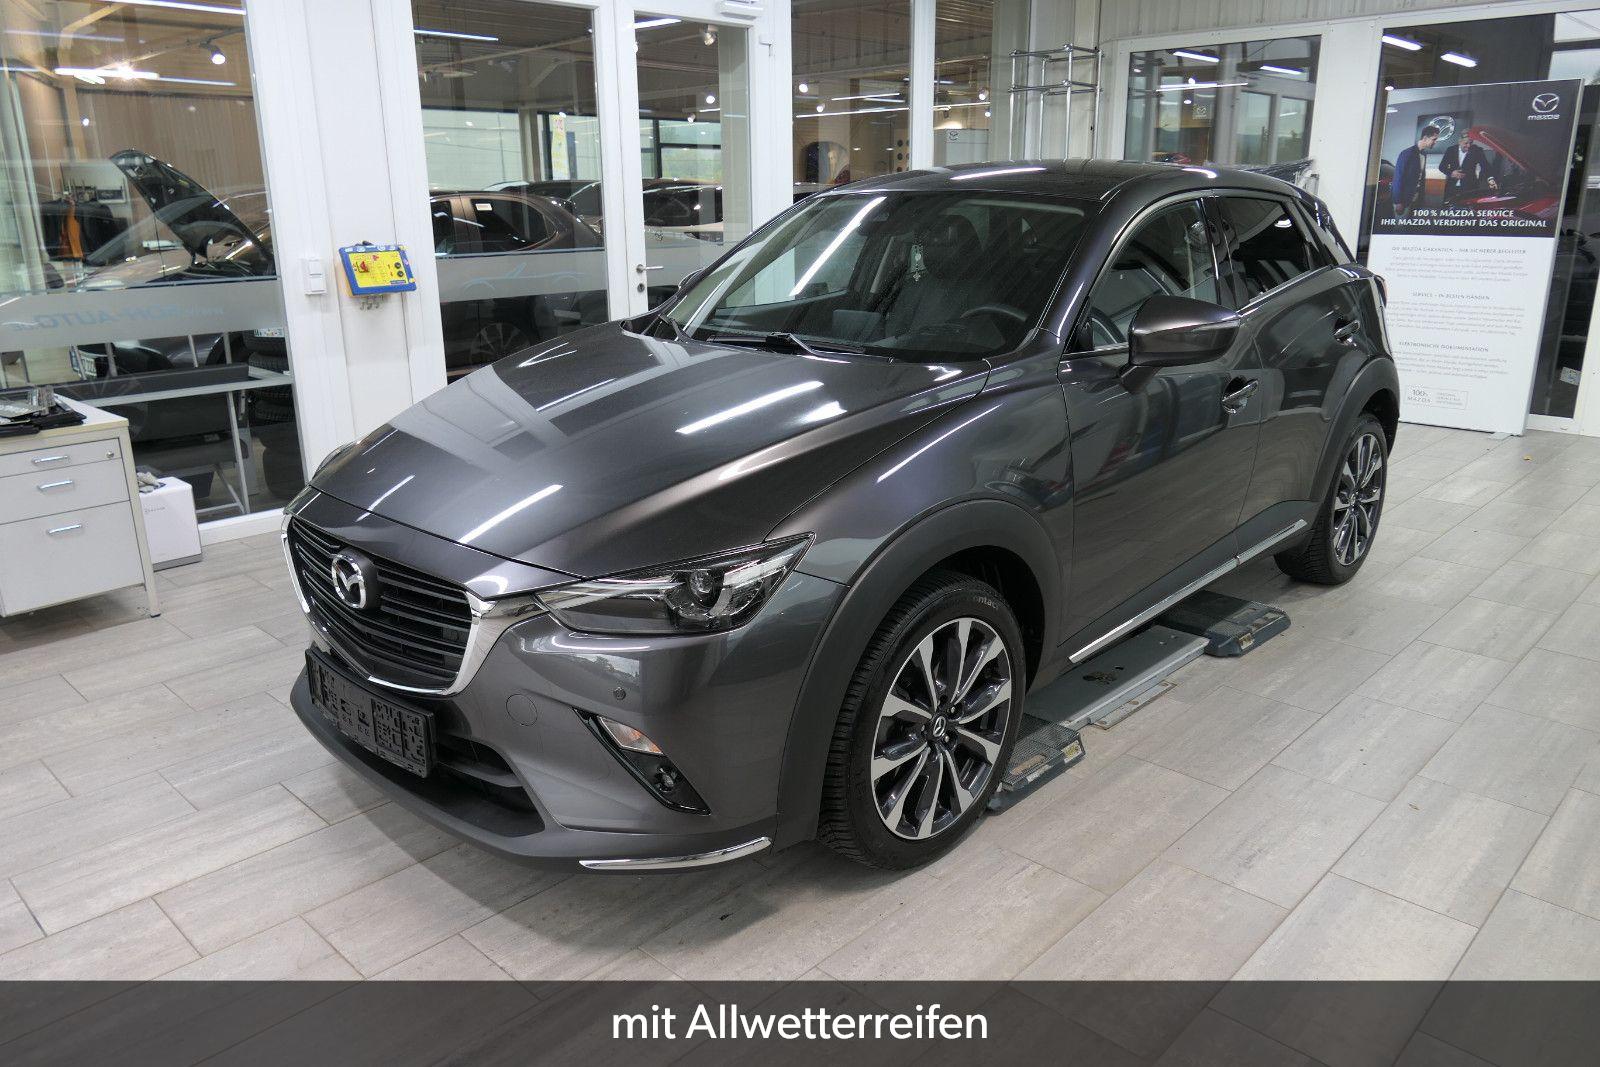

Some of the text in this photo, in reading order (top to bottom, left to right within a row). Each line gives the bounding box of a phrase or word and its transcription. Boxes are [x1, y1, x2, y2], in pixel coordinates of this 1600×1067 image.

[1412, 209, 1429, 217] 100
[1440, 209, 1474, 217] MAZDA
[1476, 209, 1514, 217] SERVICE
[1397, 218, 1431, 226] MAZDA
[1433, 218, 1477, 226] VERDIENT
[1479, 219, 1499, 227] DAS
[1500, 219, 1547, 228] ORIGINAL
